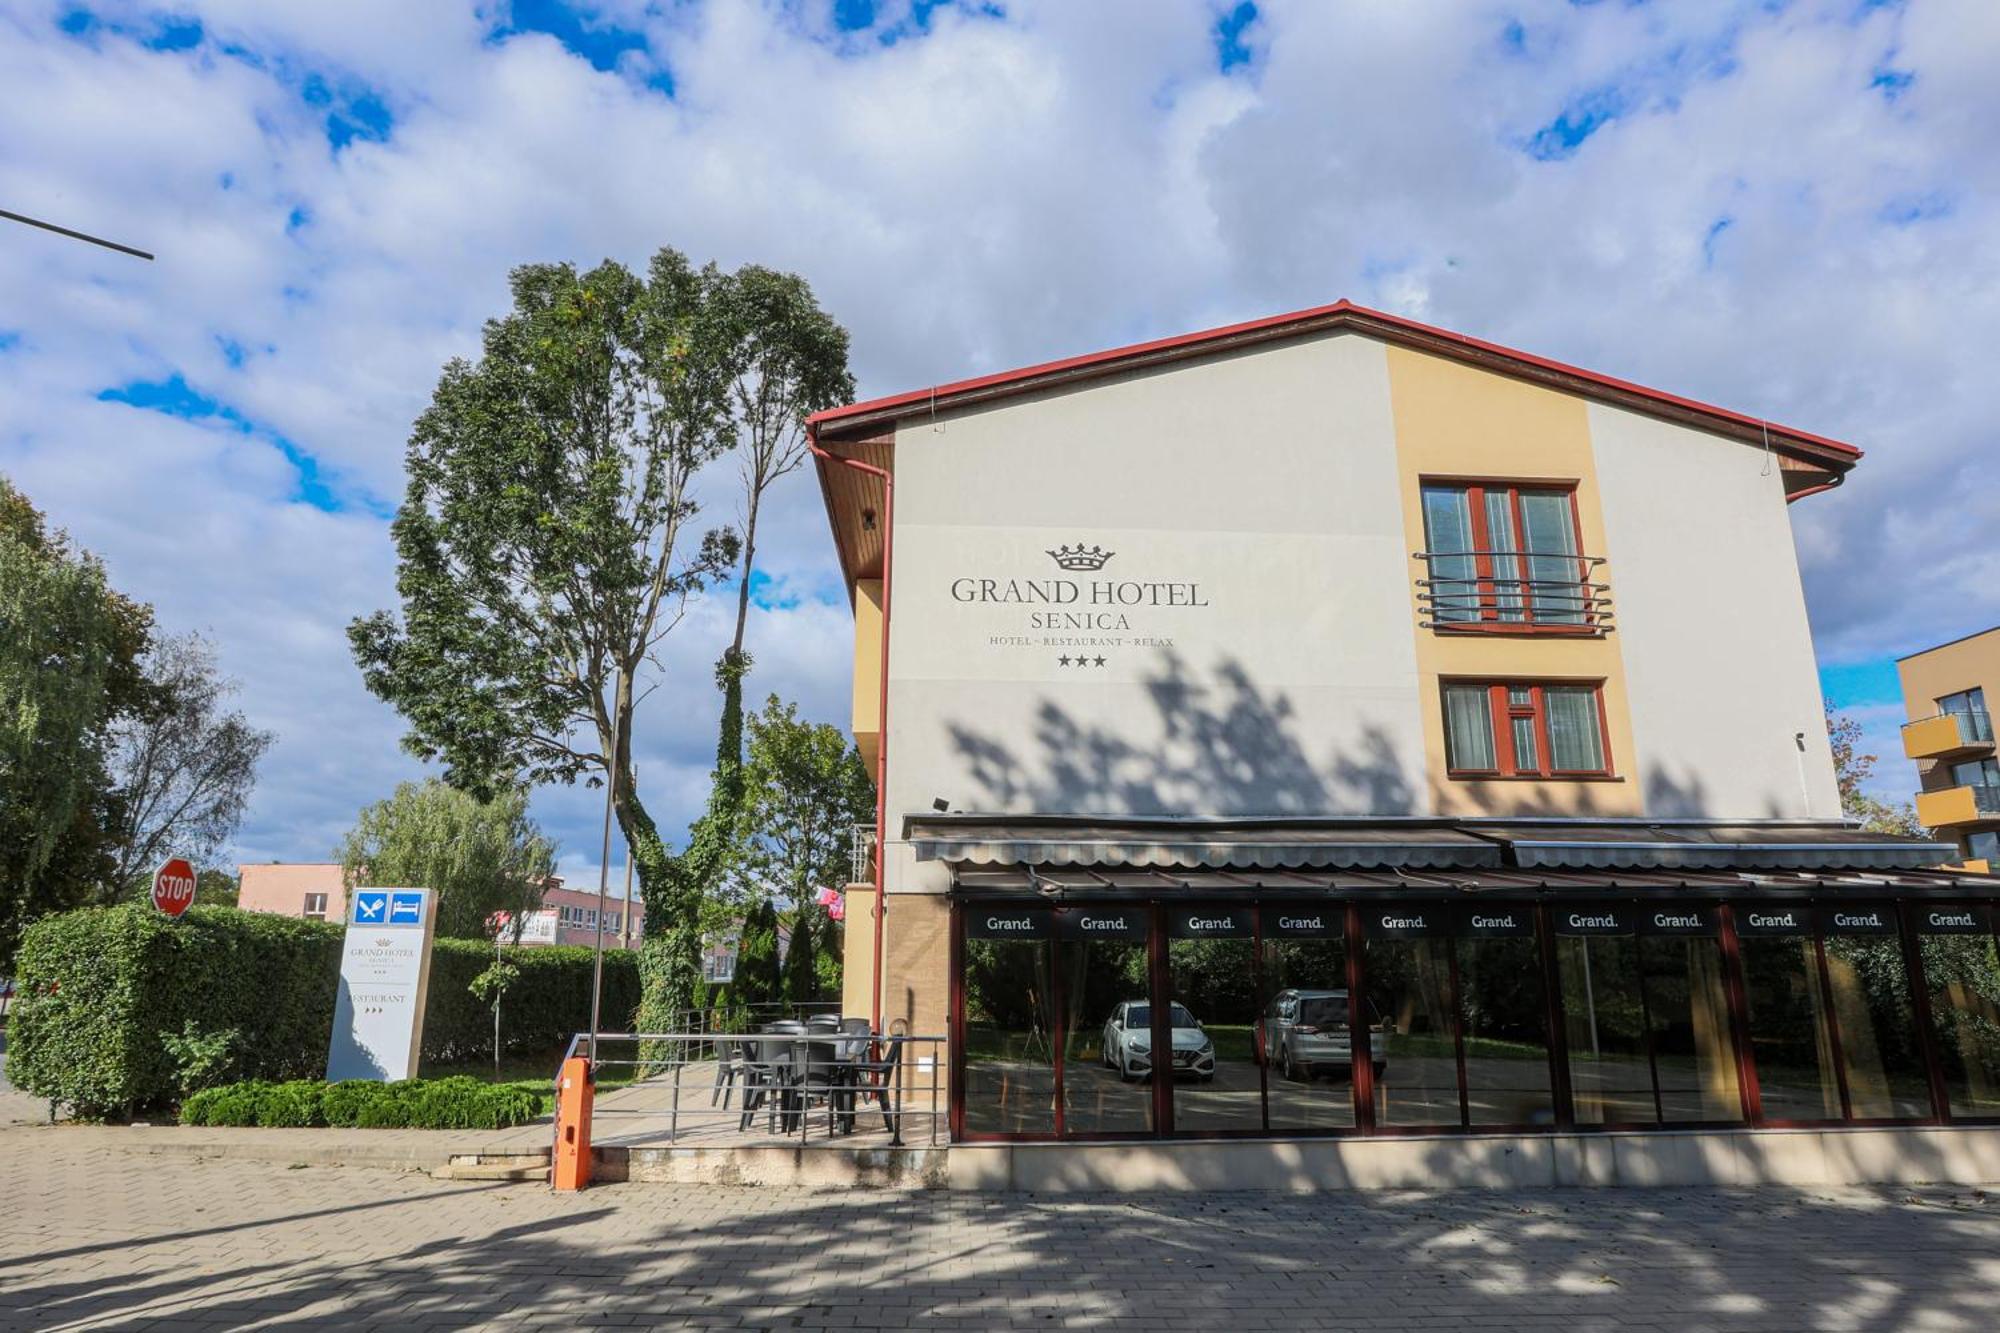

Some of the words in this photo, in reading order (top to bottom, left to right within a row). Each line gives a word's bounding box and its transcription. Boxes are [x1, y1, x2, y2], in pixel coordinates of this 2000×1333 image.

[951, 577, 1079, 604] GRAND
[1090, 581, 1209, 607] HOTEL
[1031, 611, 1130, 630] SENICA
[989, 636, 1031, 646] HOTEL
[1043, 637, 1122, 647] RESTAURANT
[1134, 637, 1174, 648] RELAX
[156, 875, 193, 898] STOP
[986, 917, 1035, 930] Grand.
[1080, 917, 1128, 930] Grand.
[1188, 916, 1235, 929] Grand.
[1279, 916, 1325, 929] Grand.
[1381, 916, 1427, 929] Grand.
[1471, 915, 1517, 928] Grand.
[1568, 914, 1618, 927] Grand.
[1654, 914, 1702, 927] Grand.
[1748, 913, 1797, 926] Grand.
[1834, 913, 1882, 926] Grand.
[1928, 912, 1976, 926] Grand.
